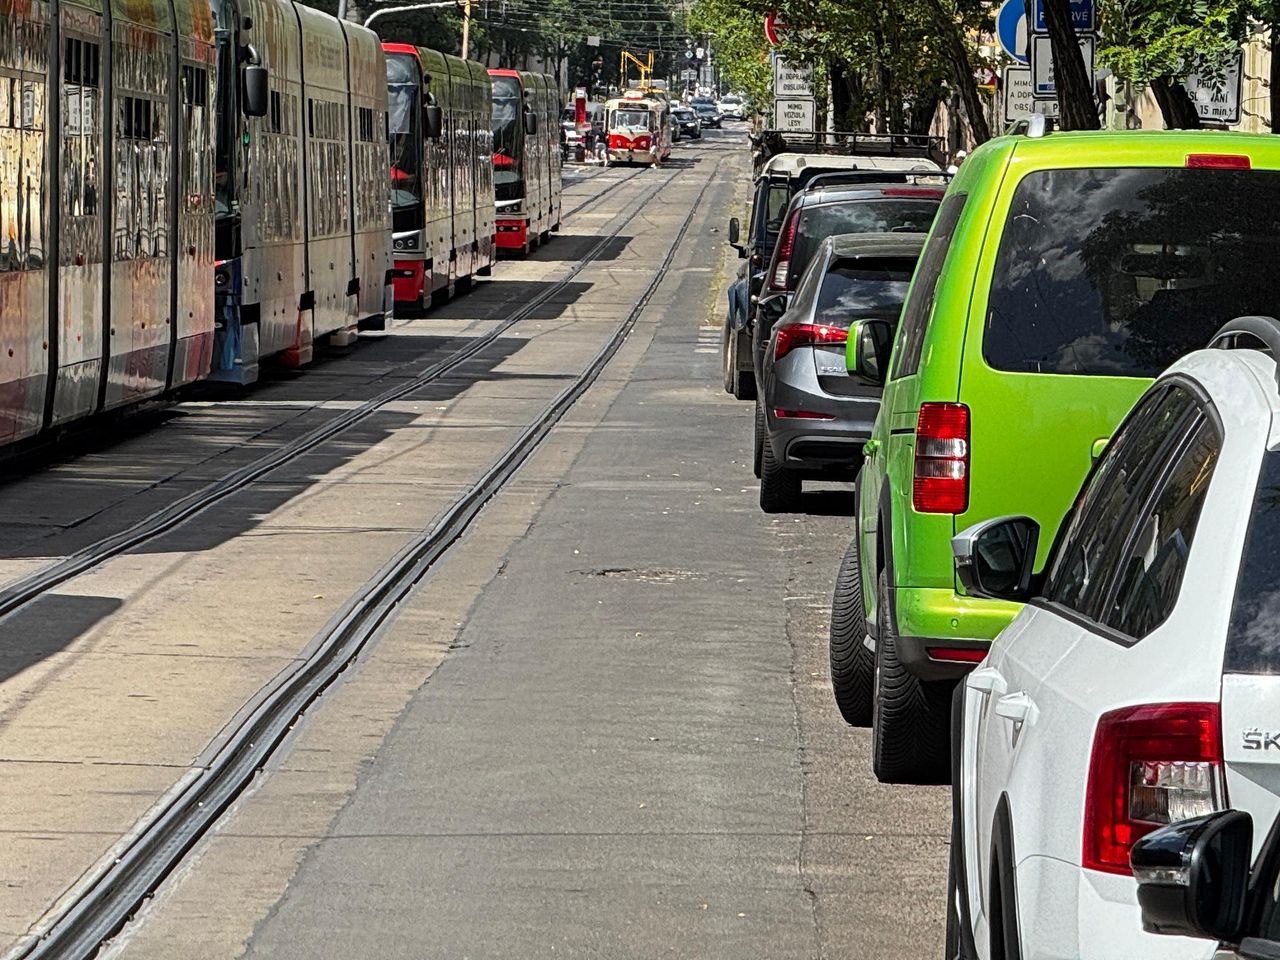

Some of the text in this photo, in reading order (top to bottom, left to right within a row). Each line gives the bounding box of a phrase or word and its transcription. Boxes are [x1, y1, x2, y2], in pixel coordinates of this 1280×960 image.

[1017, 91, 1033, 99] DOP
[1014, 103, 1029, 111] OBS
[1200, 104, 1209, 115] 15
